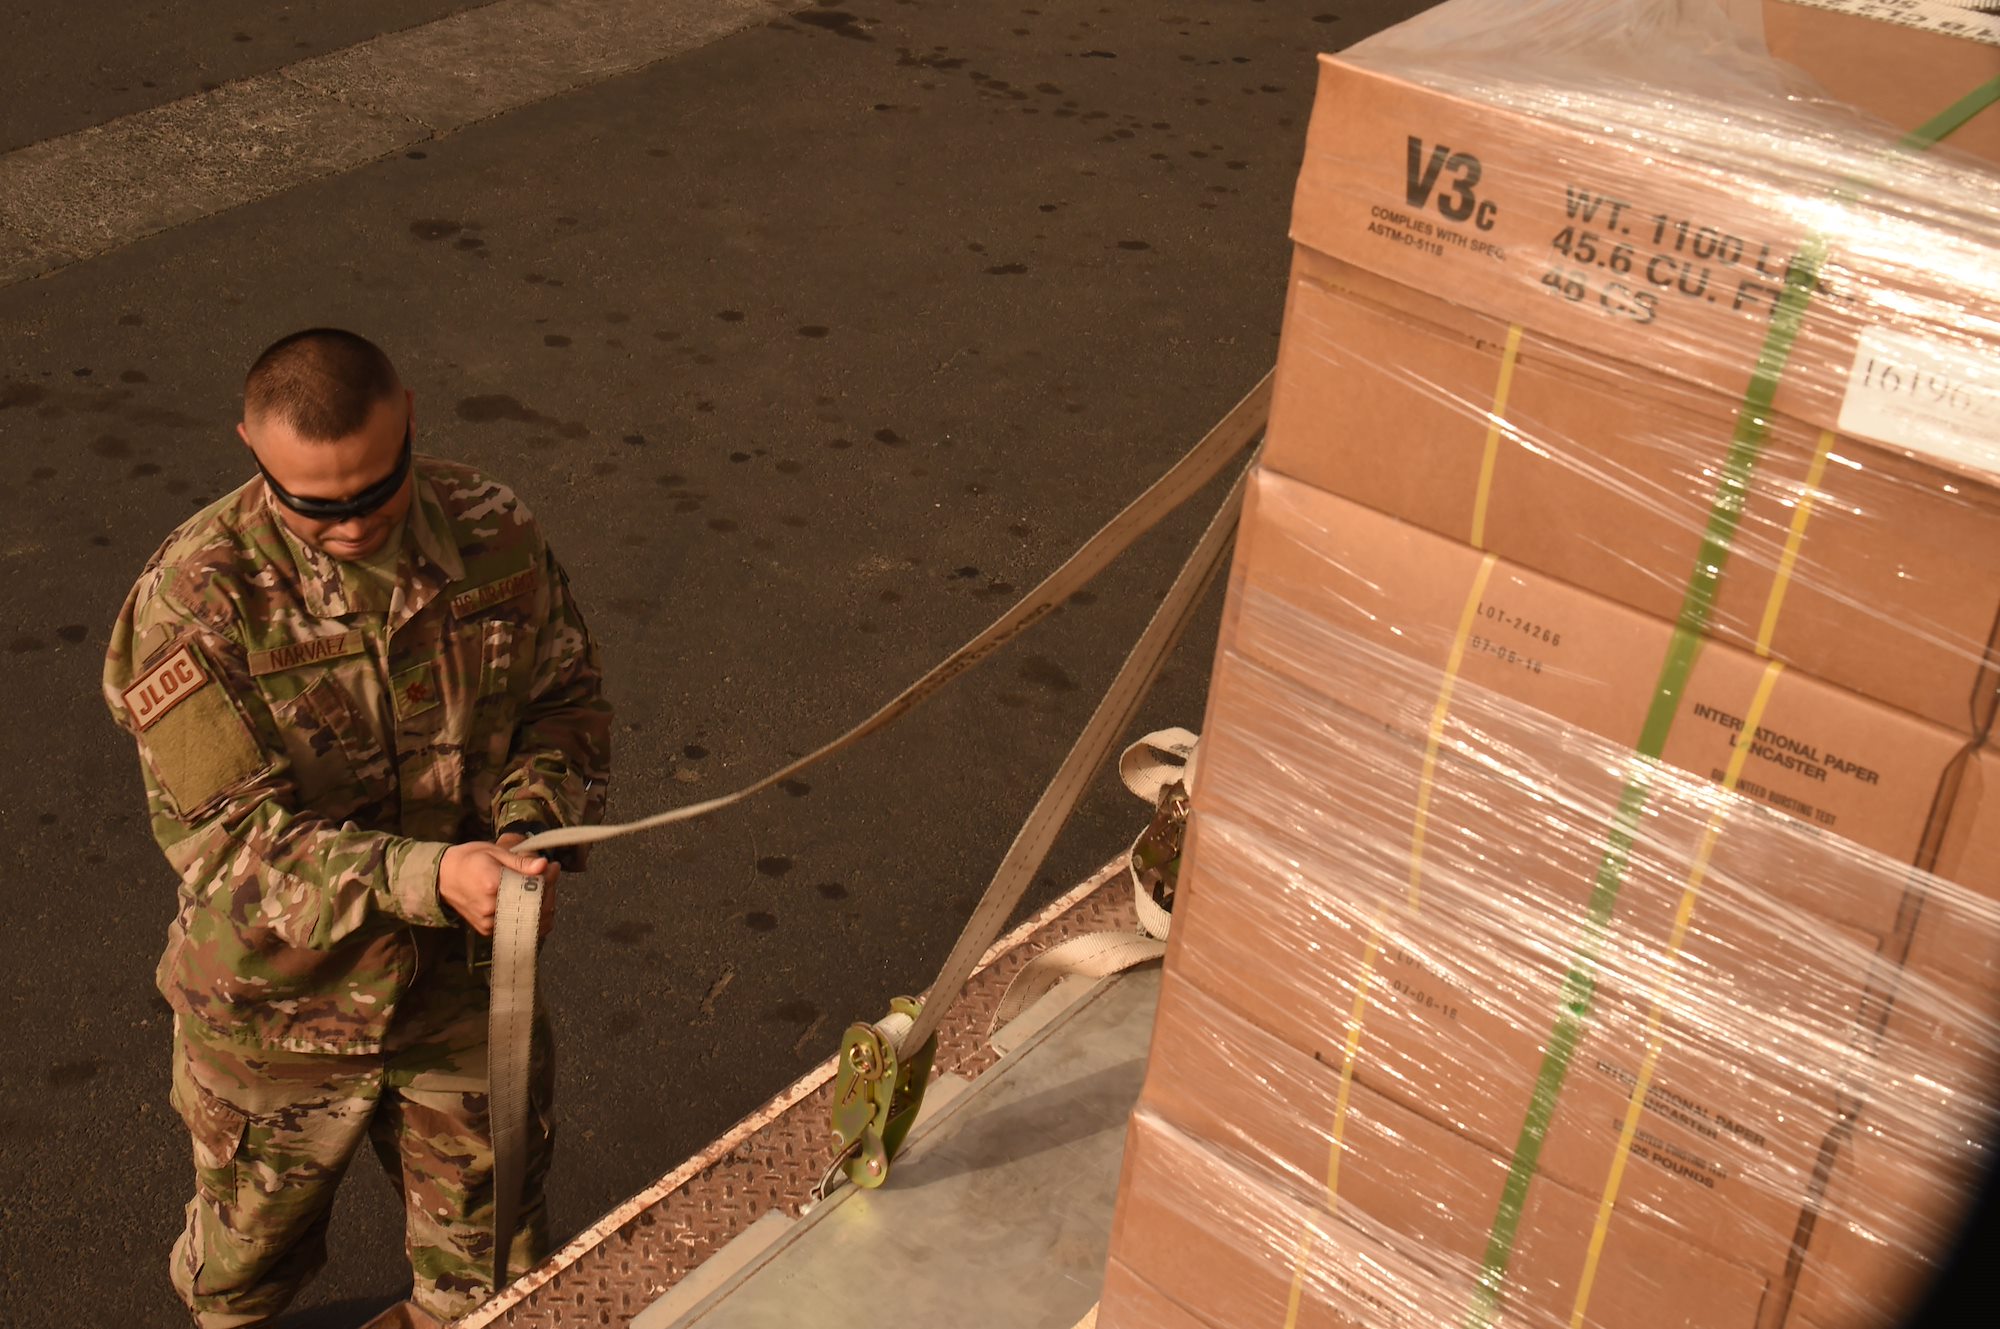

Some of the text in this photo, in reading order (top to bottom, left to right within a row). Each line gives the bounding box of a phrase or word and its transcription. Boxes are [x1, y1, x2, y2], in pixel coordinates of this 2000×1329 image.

[1368, 221, 1444, 256] ASTM-D-5118
[1371, 205, 1433, 236] COMPLIES
[1436, 226, 1468, 249] WITH
[1565, 185, 1631, 235] WT.
[1651, 214, 1744, 268] 1100
[1552, 225, 1635, 275] 45.6
[1646, 254, 1716, 302] CU.
[1476, 602, 1560, 647] LOT-24266
[270, 637, 346, 670] NARVAEZ
[139, 658, 195, 717] JLOC
[1694, 703, 1880, 785] INTERATIONAL PAPER
[1729, 733, 1828, 782] LNCASTER
[1815, 808, 1837, 827] TEST
[1715, 1114, 1766, 1149] PAPER
[1652, 1153, 1715, 1189] POUNDS
